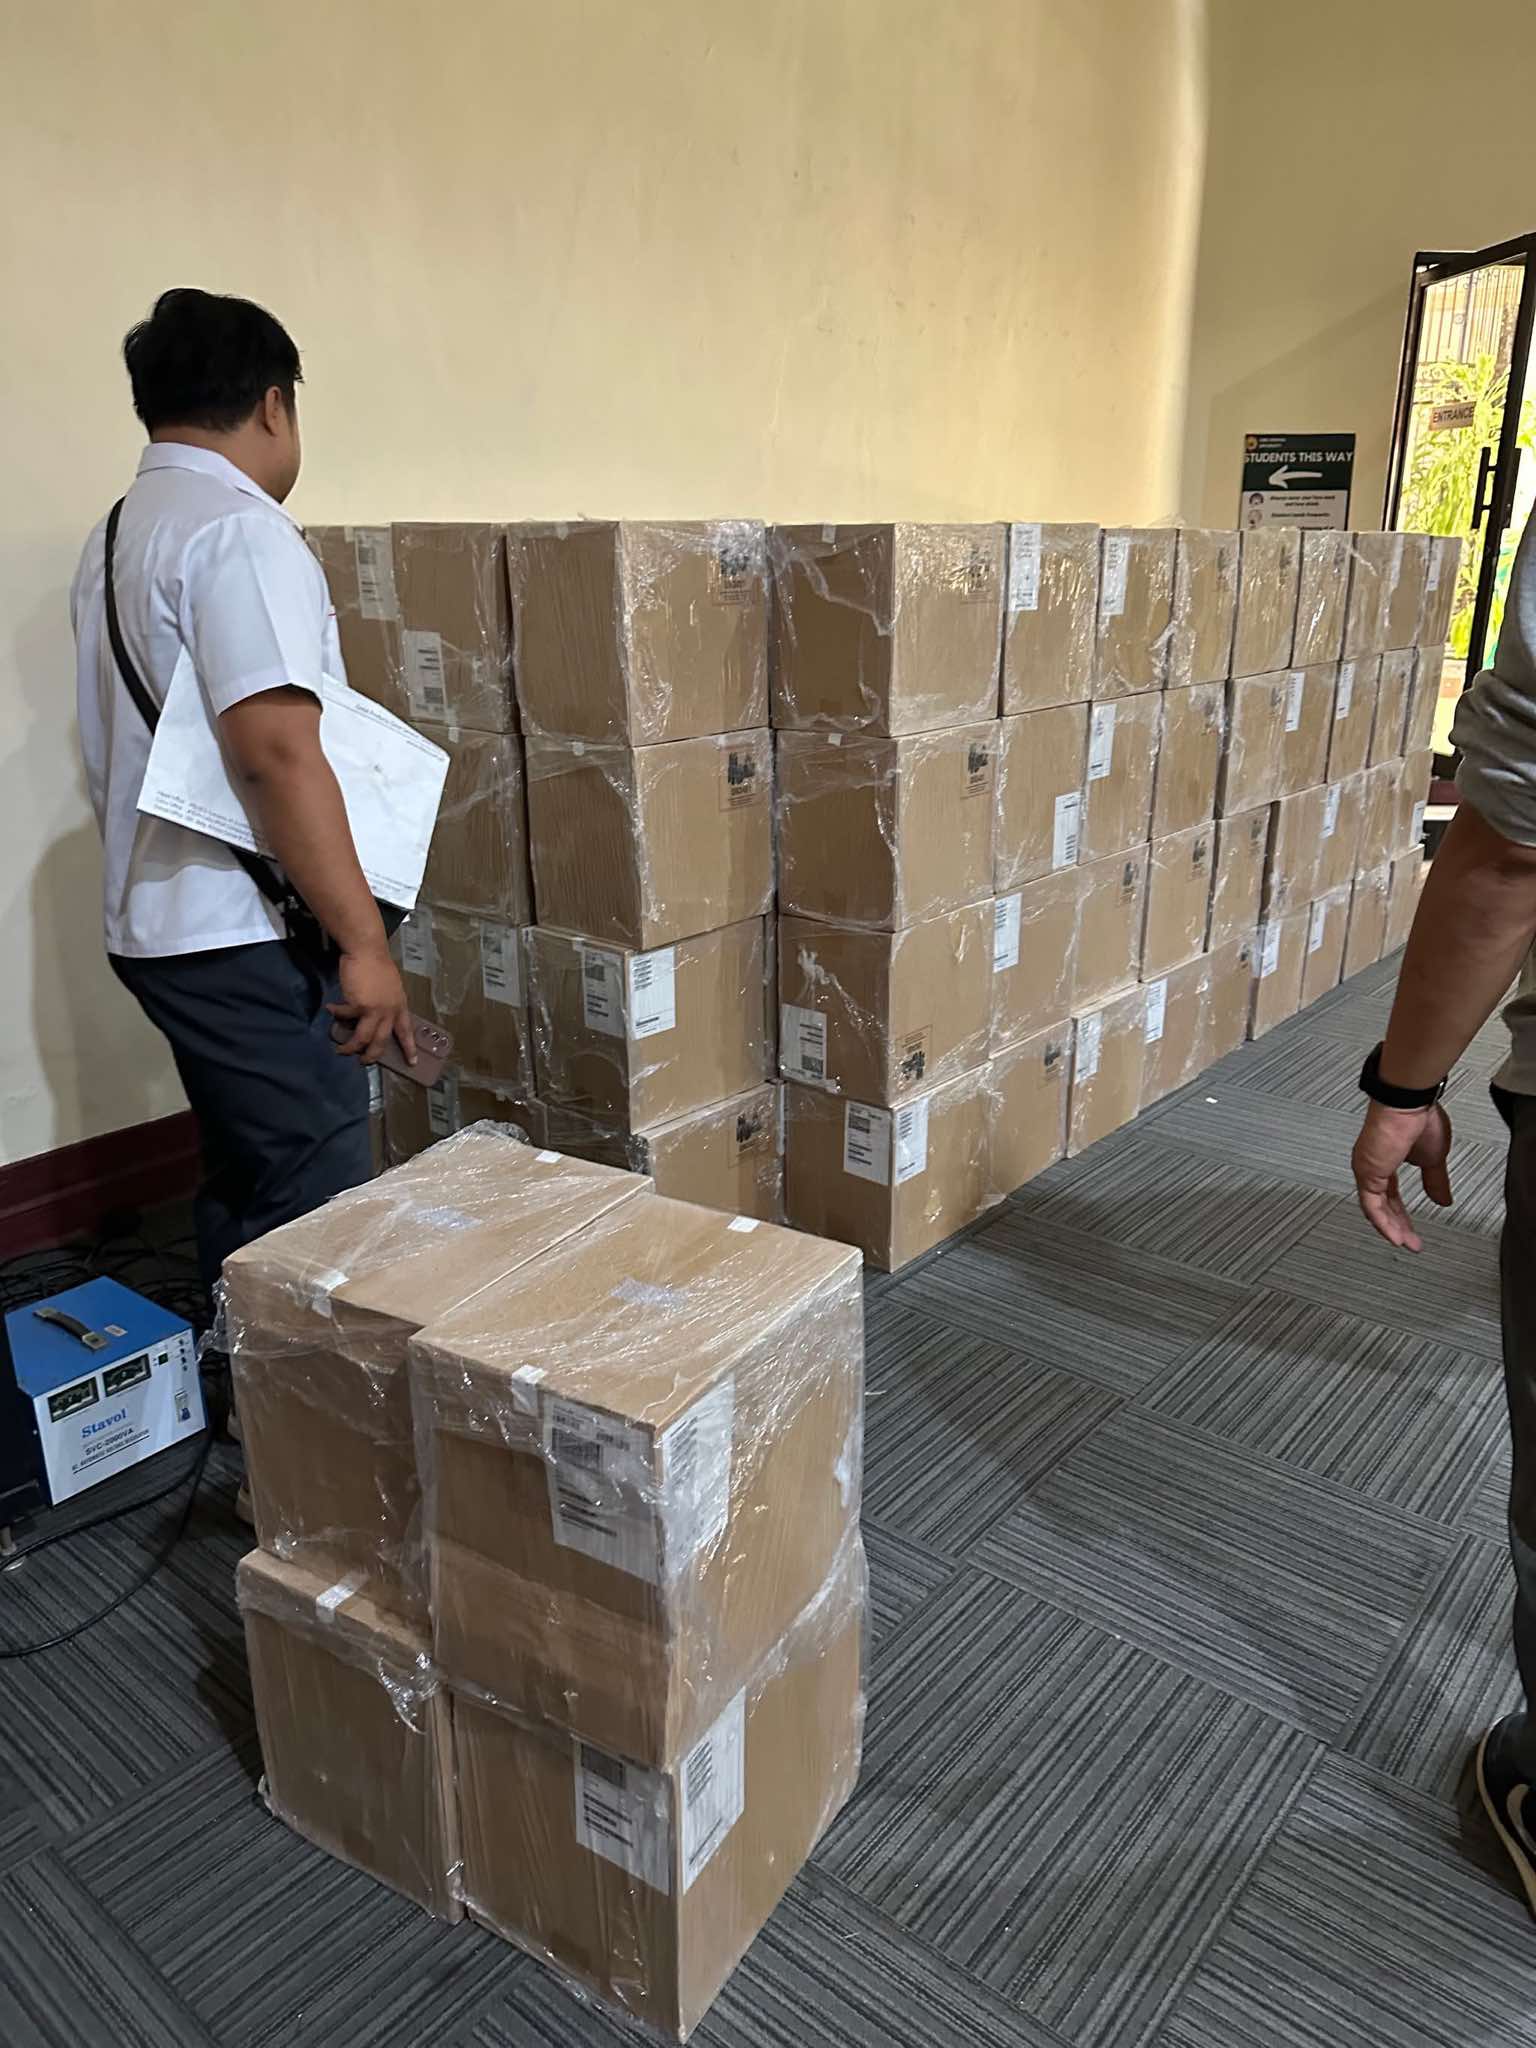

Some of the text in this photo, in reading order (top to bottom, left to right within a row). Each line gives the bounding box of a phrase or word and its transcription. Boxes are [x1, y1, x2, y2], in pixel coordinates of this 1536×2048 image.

[1432, 406, 1475, 423] ENTRANCE
[1244, 452, 1353, 462] STUDENTS THIS WAY
[82, 1408, 127, 1438] Stavol
